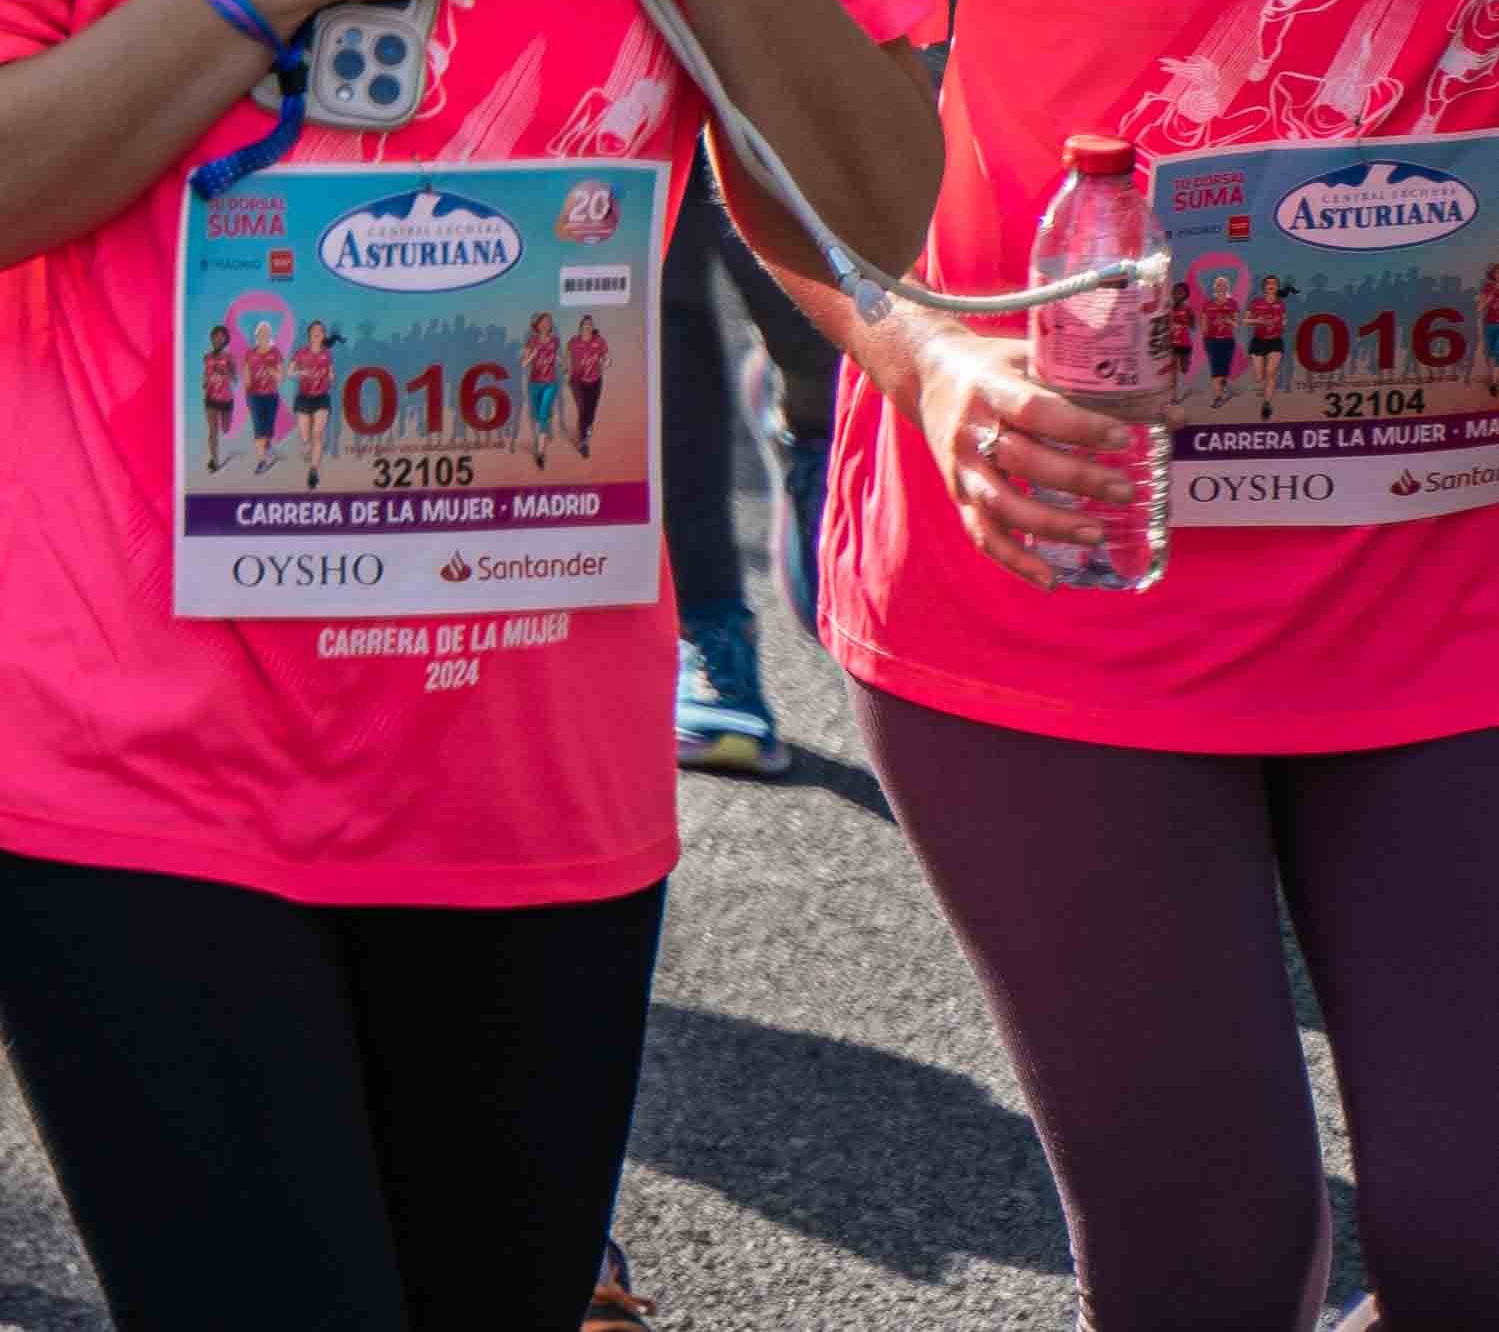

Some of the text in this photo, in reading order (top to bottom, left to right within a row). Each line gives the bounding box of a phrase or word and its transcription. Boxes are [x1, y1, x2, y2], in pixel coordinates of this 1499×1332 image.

[568, 191, 608, 223] 20
[1173, 188, 1244, 211] SUMA
[1290, 197, 1465, 231] ASTURIANA
[207, 214, 285, 237] SUMA
[335, 229, 509, 268] ASTURIANA
[1295, 308, 1467, 373] 016
[342, 363, 512, 435] 016
[1323, 388, 1425, 419] 32104
[1193, 431, 1296, 452] CARRERA
[1302, 428, 1330, 449] DE
[1337, 427, 1366, 447] LA
[1372, 423, 1447, 446] MUJER
[373, 456, 473, 488] 32105
[1188, 473, 1335, 503] OYSHO
[1424, 467, 1499, 493] Santa
[236, 493, 601, 526] CARRERA DE LA MUJER MADRID
[232, 552, 384, 587] OYSHO
[477, 551, 607, 583] Santander
[317, 613, 570, 658] CARRERA DE LA MUJER
[424, 660, 480, 693] 2024
